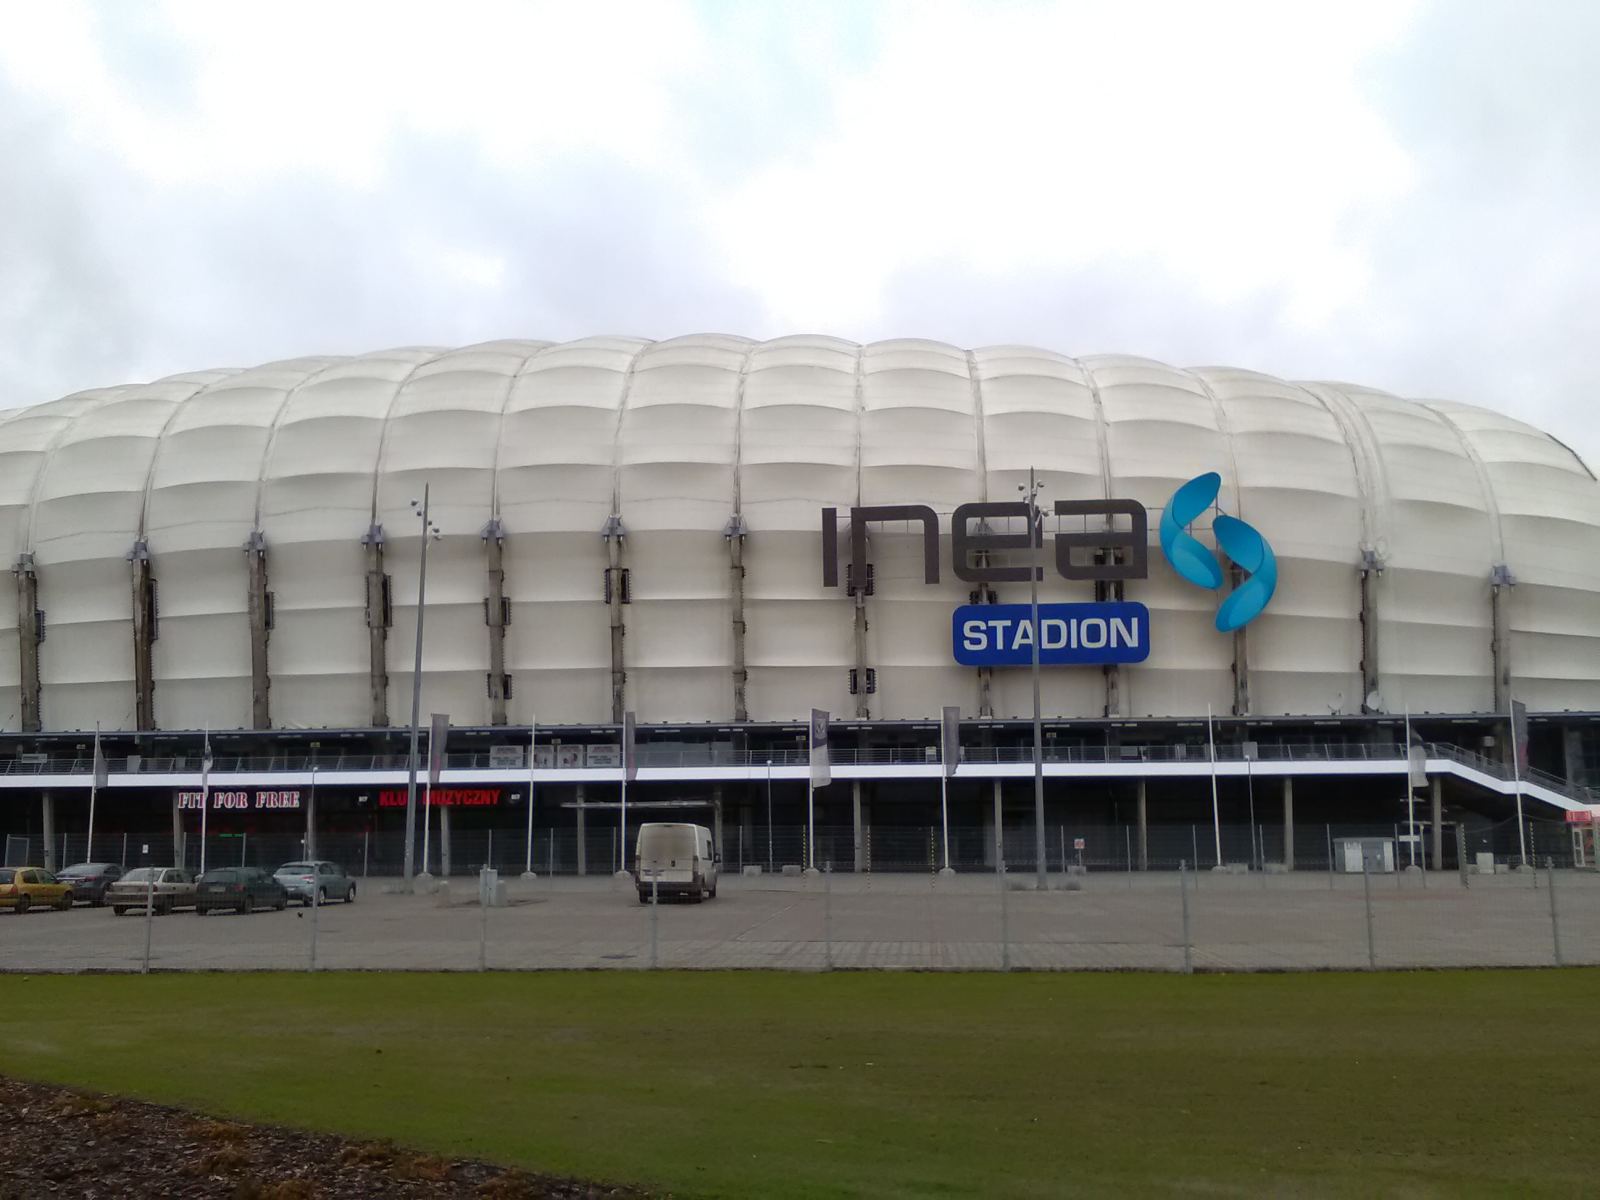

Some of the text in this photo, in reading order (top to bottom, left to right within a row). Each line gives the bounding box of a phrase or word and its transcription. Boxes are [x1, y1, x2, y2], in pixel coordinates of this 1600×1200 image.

[963, 617, 1139, 651] STADION
[178, 791, 300, 808] FIT FOR FREE
[379, 790, 415, 806] KLU
